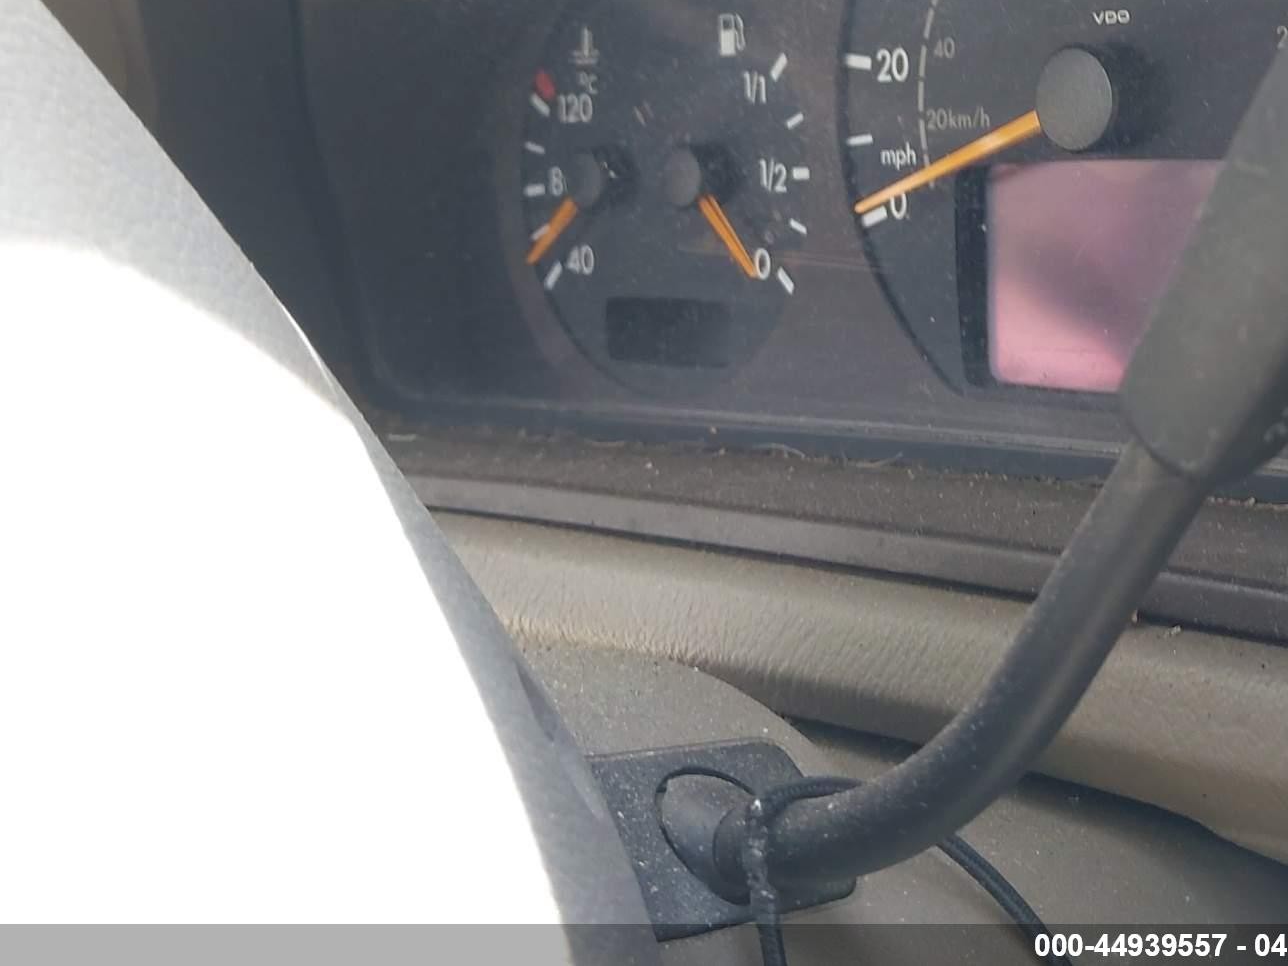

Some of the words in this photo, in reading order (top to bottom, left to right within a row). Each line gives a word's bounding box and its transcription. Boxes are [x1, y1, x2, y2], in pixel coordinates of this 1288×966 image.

[1093, 11, 1130, 24] VDO
[934, 38, 955, 59] 40
[876, 48, 909, 83] 20
[743, 71, 766, 104] 1/1
[558, 93, 593, 123] 120
[880, 141, 917, 171] mph
[759, 158, 788, 193] 1/2
[889, 192, 907, 220] 0
[567, 244, 594, 275] 40
[755, 247, 771, 280] 0
